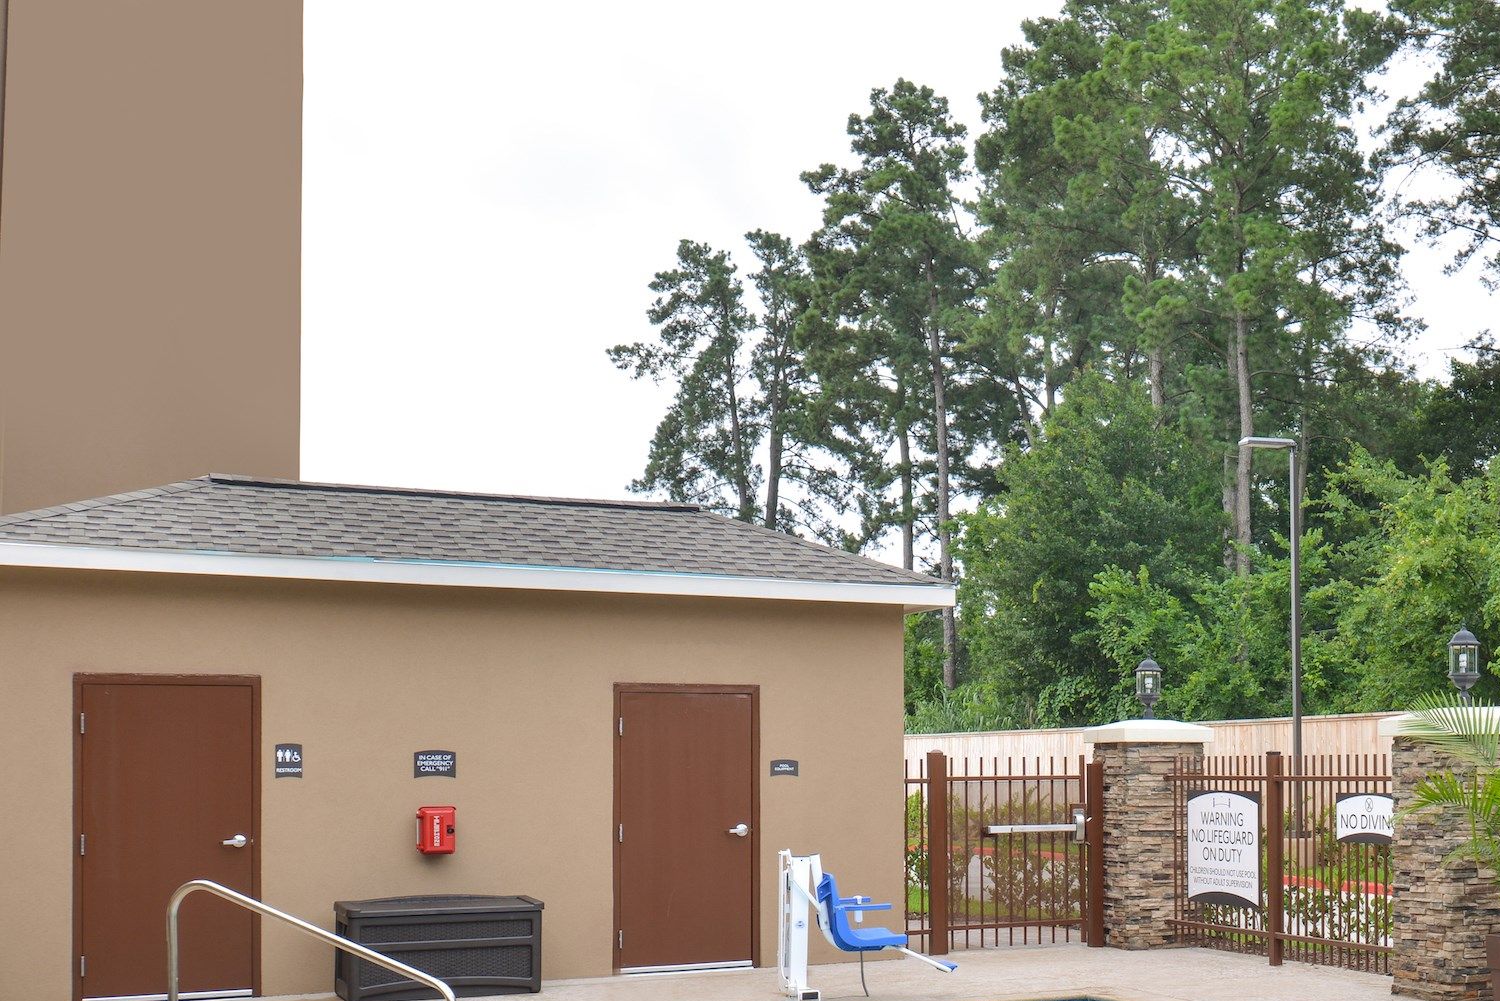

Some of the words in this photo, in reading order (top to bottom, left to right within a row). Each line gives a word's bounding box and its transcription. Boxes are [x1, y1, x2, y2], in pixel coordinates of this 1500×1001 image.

[1200, 811, 1244, 827] WARNING
[1341, 813, 1358, 830] NO
[1361, 814, 1394, 831] DIVIN
[1191, 828, 1206, 843] NO
[1207, 829, 1254, 846] LIFEGUARD
[1202, 846, 1217, 862] ON
[1219, 848, 1243, 863] DUTY
[1190, 865, 1209, 875] CHILDREN
[1209, 867, 1226, 877] SHOULD
[1226, 868, 1236, 877] NOT
[1236, 869, 1244, 878] USE
[1245, 870, 1257, 879] POOL
[1193, 876, 1213, 885] WITHOUT
[1213, 877, 1226, 887] ADULT
[1226, 878, 1253, 889] SUPERVISION
